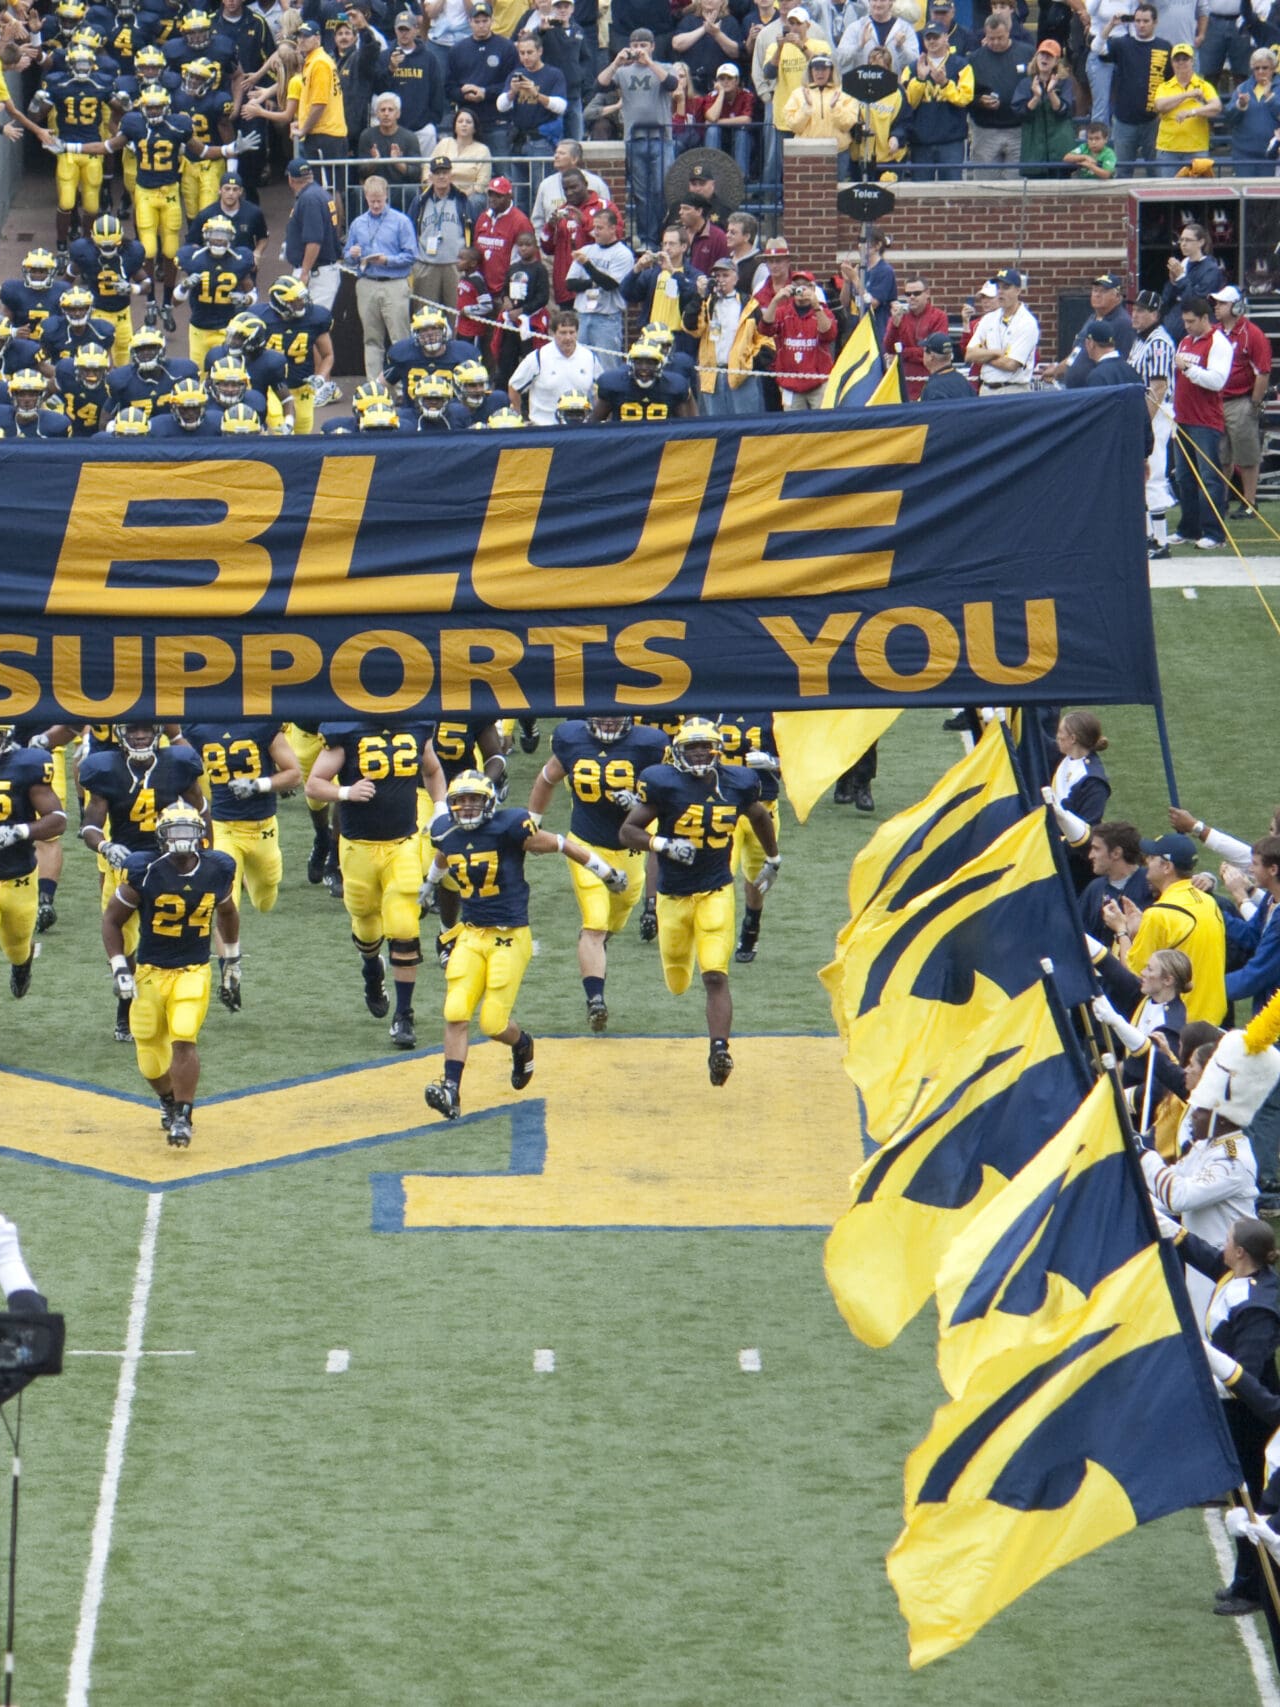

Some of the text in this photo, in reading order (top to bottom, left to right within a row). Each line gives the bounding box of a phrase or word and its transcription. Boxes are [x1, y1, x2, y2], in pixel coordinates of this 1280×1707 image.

[114, 29, 133, 56] 4
[628, 75, 652, 91] M
[857, 70, 883, 80] Telex
[137, 139, 173, 171] 12
[435, 157, 444, 165] M
[854, 189, 879, 199] Telex
[198, 271, 237, 304] 12
[29, 310, 51, 339] 7
[267, 333, 308, 364] 44
[44, 424, 929, 617] BLUE
[758, 598, 1058, 698] YOU
[203, 740, 261, 784] 83
[358, 734, 419, 780] 62
[573, 759, 635, 803] 89
[130, 788, 158, 832] 4
[261, 830, 274, 840] M
[673, 804, 738, 849] 45
[628, 848, 641, 857] M
[15, 876, 30, 887] M
[446, 851, 501, 899] 37
[152, 893, 216, 938] 24
[495, 937, 513, 947] M
